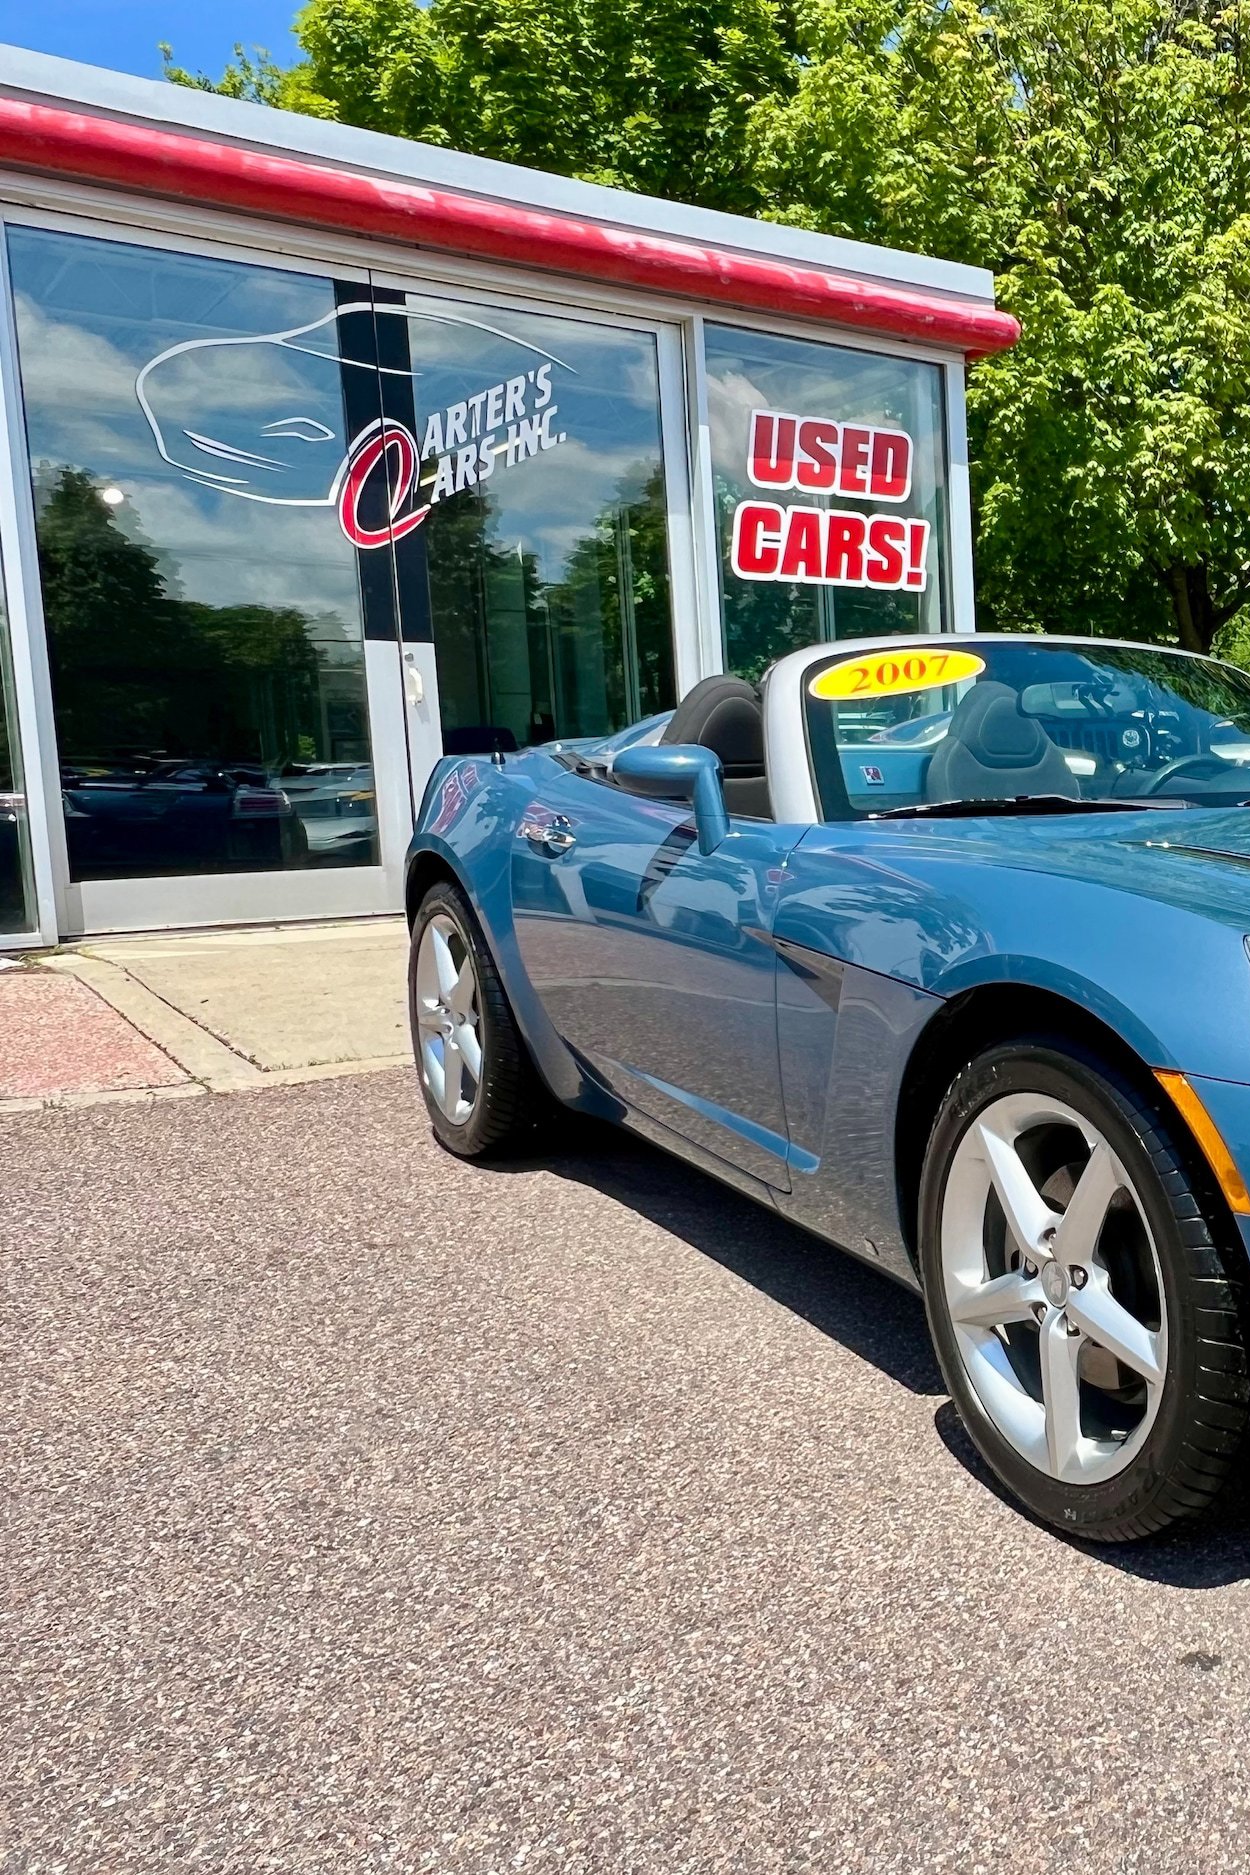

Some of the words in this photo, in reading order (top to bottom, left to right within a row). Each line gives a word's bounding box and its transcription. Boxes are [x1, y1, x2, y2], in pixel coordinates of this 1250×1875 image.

[505, 404, 567, 468] INC.
[751, 413, 910, 498] USED
[736, 504, 927, 587] CARS!
[849, 654, 950, 694] 2007
